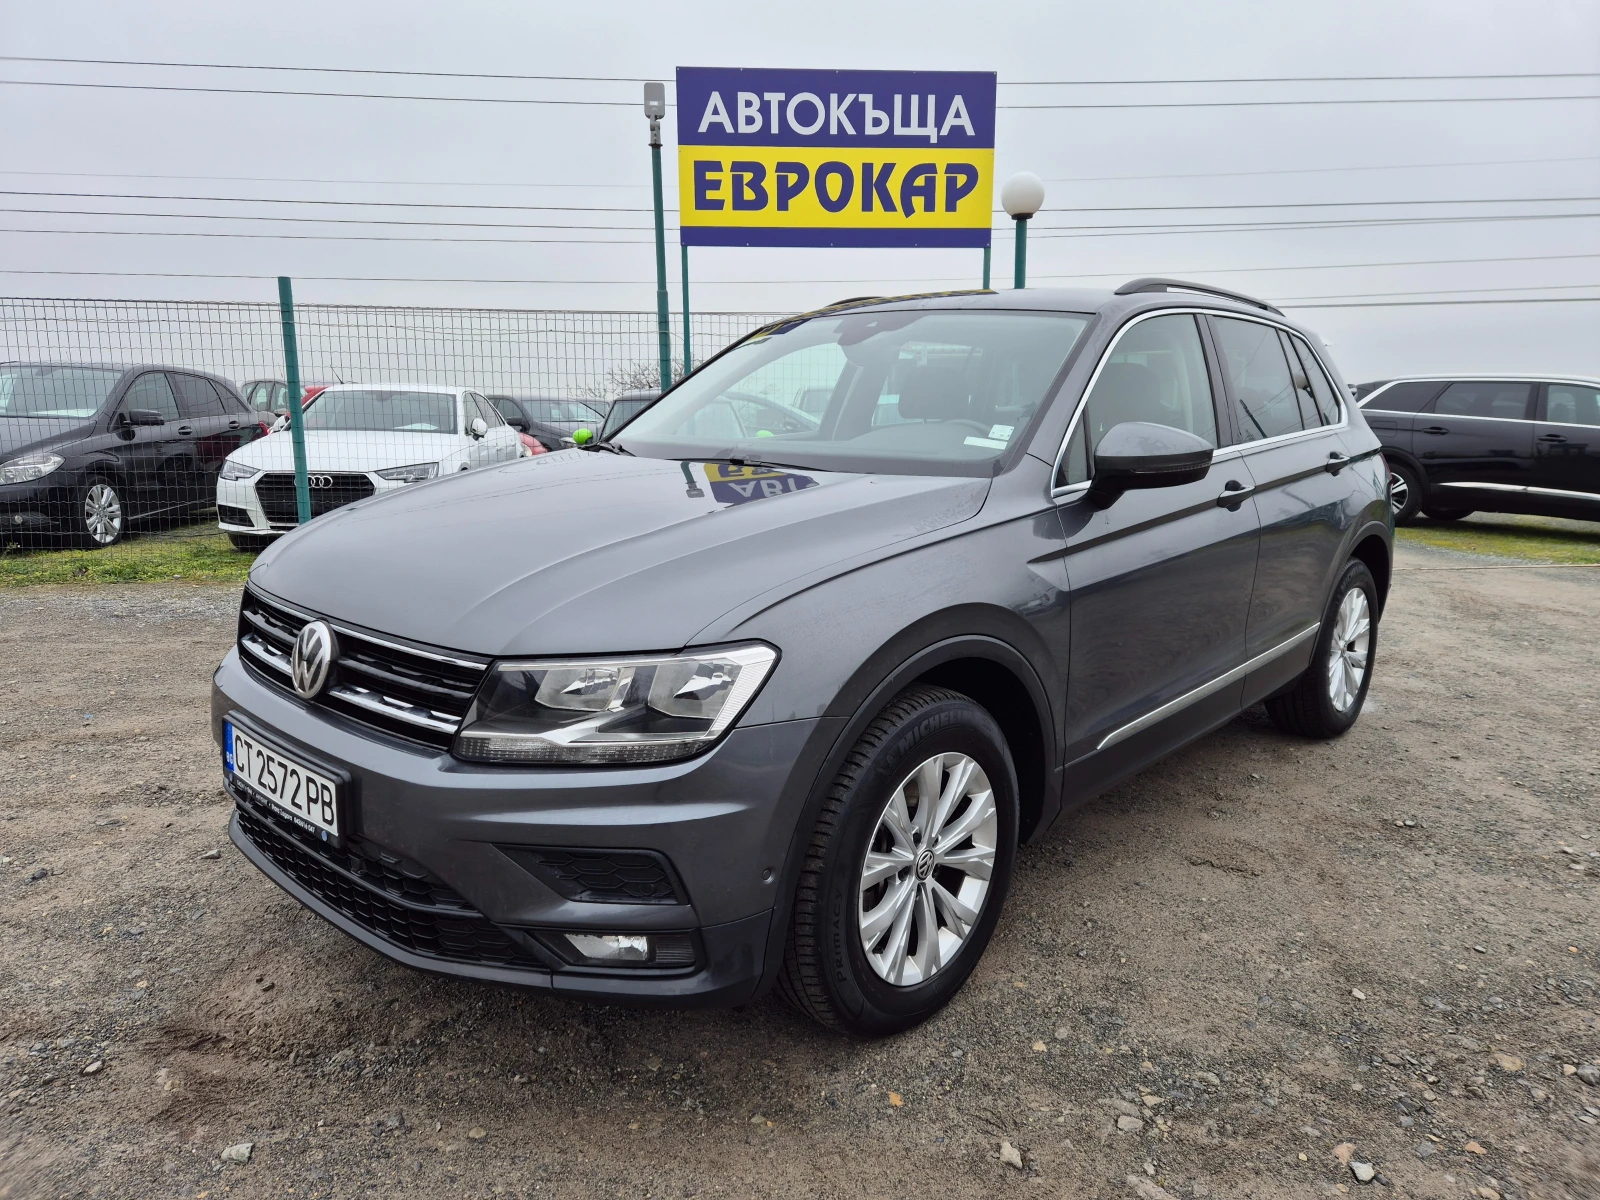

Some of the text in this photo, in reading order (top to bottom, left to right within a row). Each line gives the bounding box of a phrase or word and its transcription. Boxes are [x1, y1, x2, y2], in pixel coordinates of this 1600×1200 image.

[697, 91, 976, 144] АВТОКЪЩА
[693, 160, 979, 218] ЕВРОКАР
[234, 734, 253, 779] CT
[256, 749, 303, 811] 2572
[305, 774, 335, 826] PB
